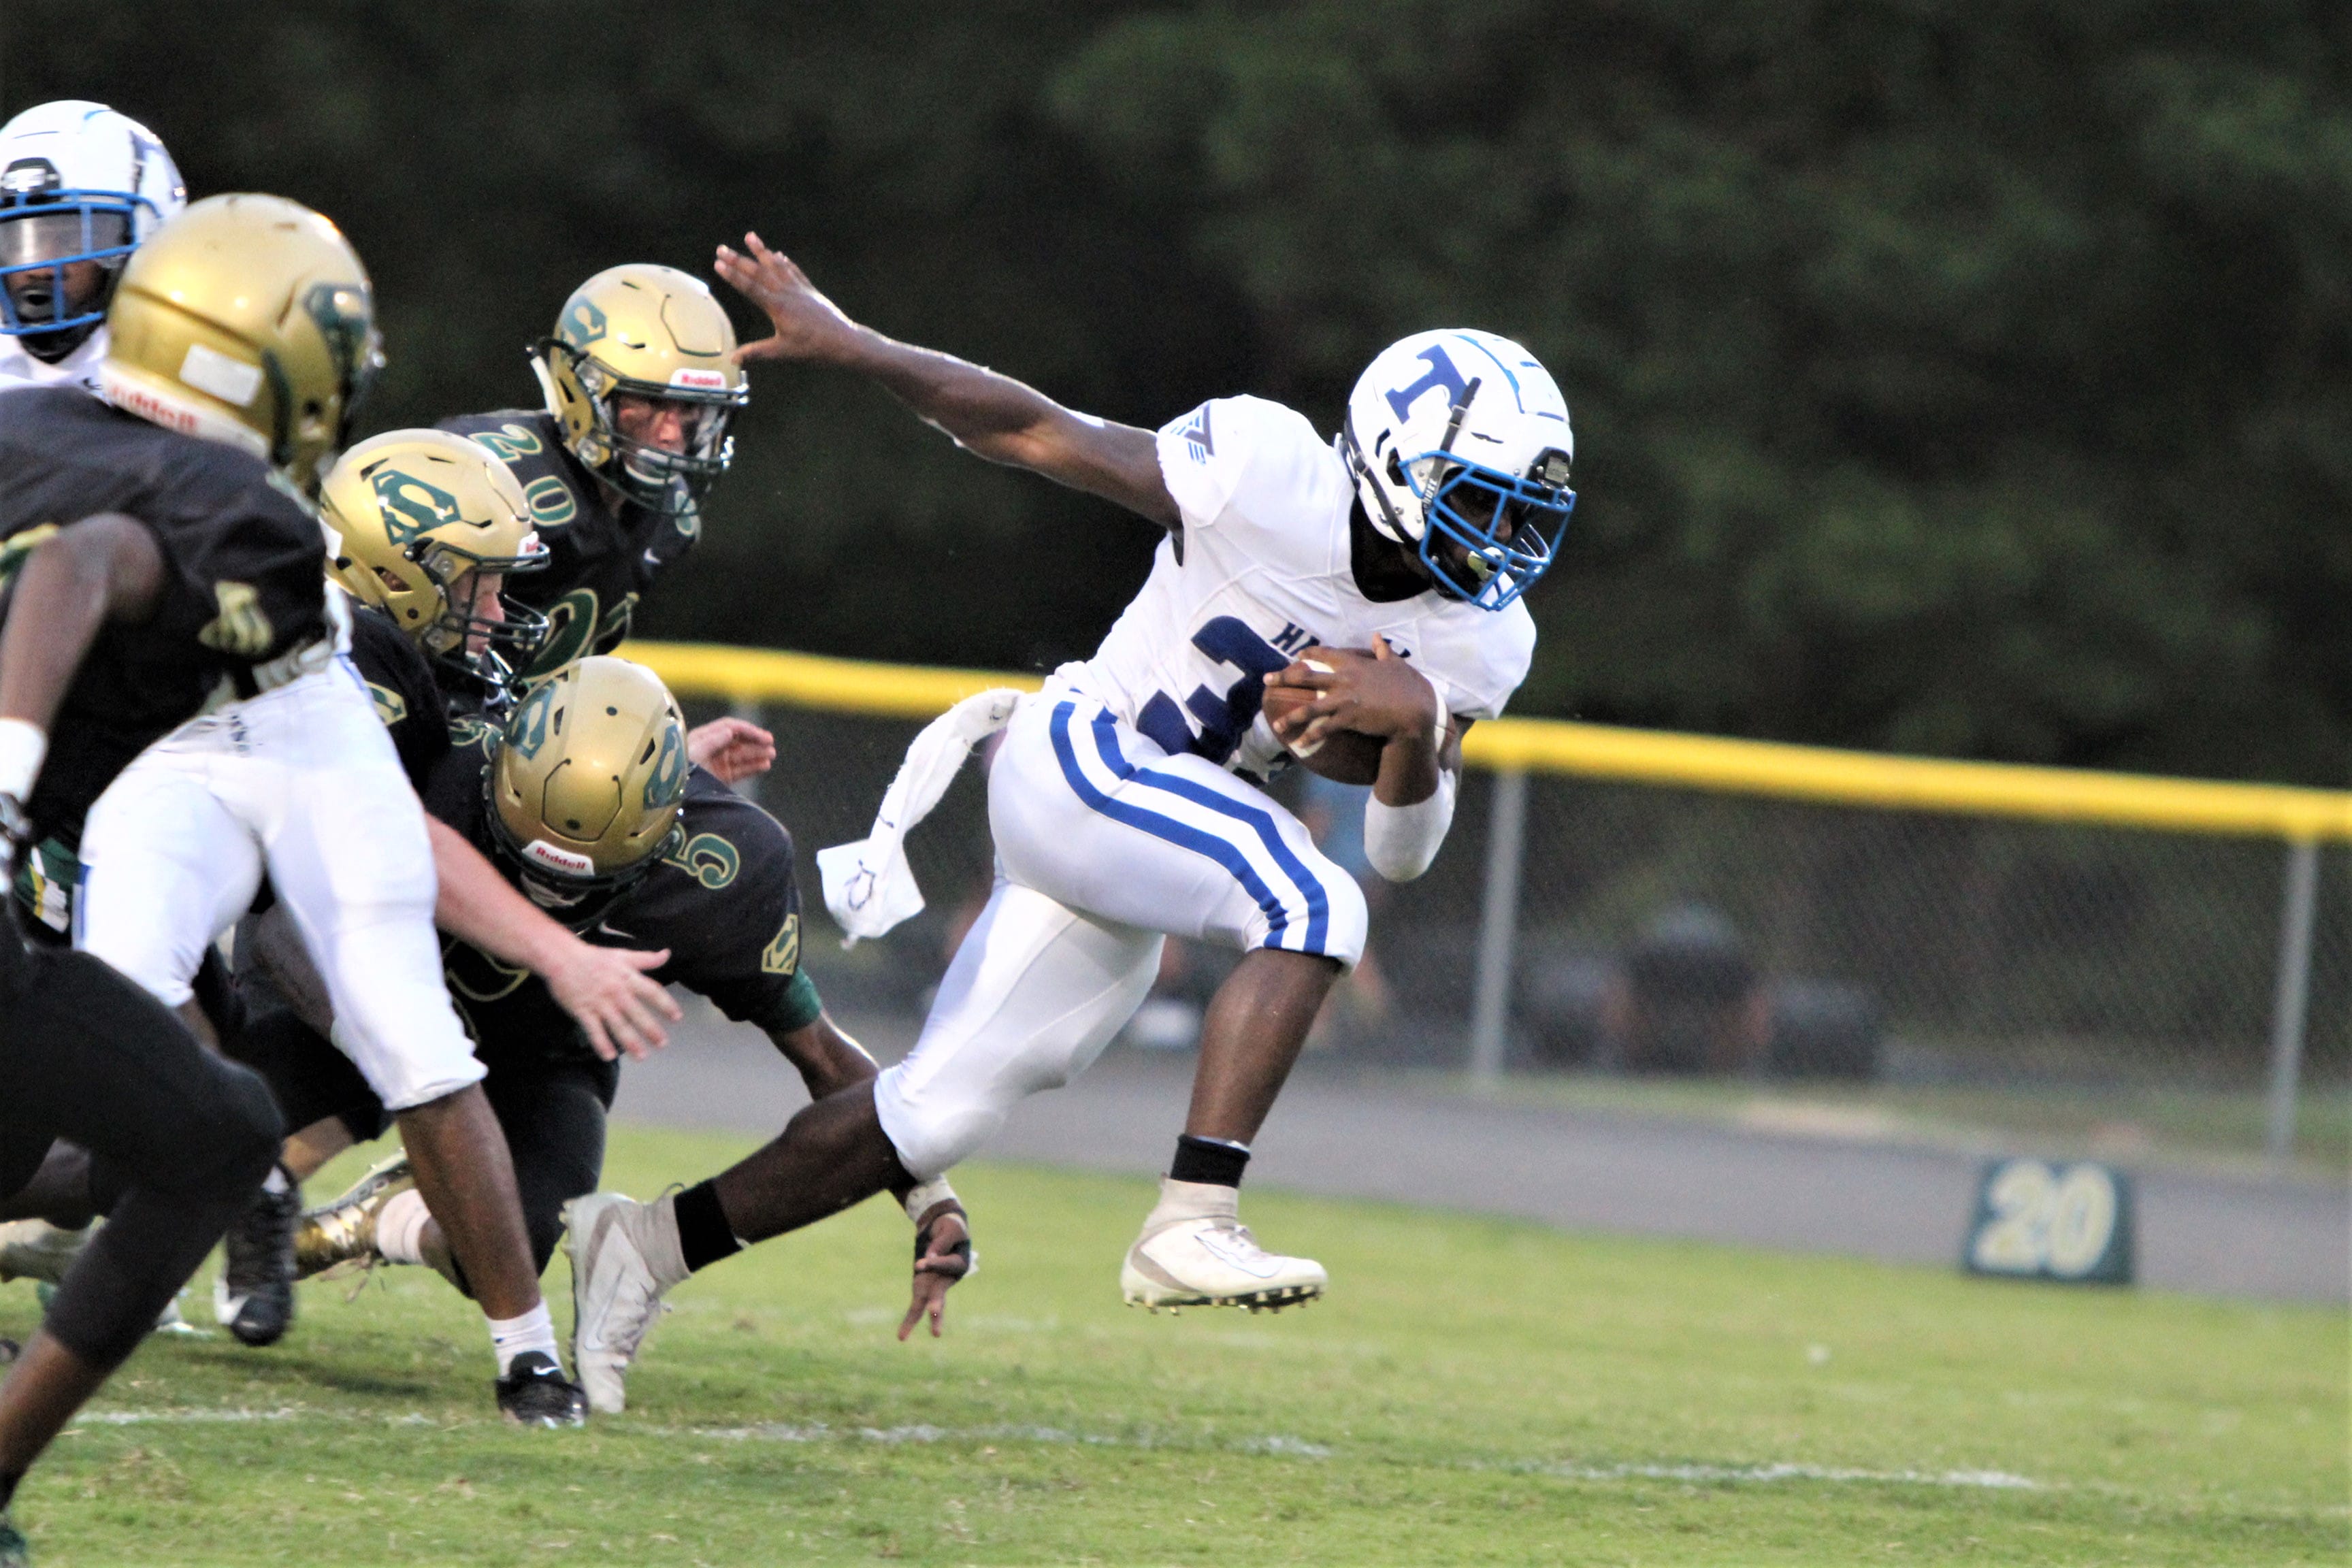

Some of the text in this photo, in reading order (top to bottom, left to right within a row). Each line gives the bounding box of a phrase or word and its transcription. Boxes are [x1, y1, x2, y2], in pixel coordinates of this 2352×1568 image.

[1385, 344, 1468, 425] T
[468, 423, 577, 527] 20
[1136, 615, 1292, 784] 3
[535, 847, 587, 869] Riddell
[1975, 1160, 2114, 1275] 20
